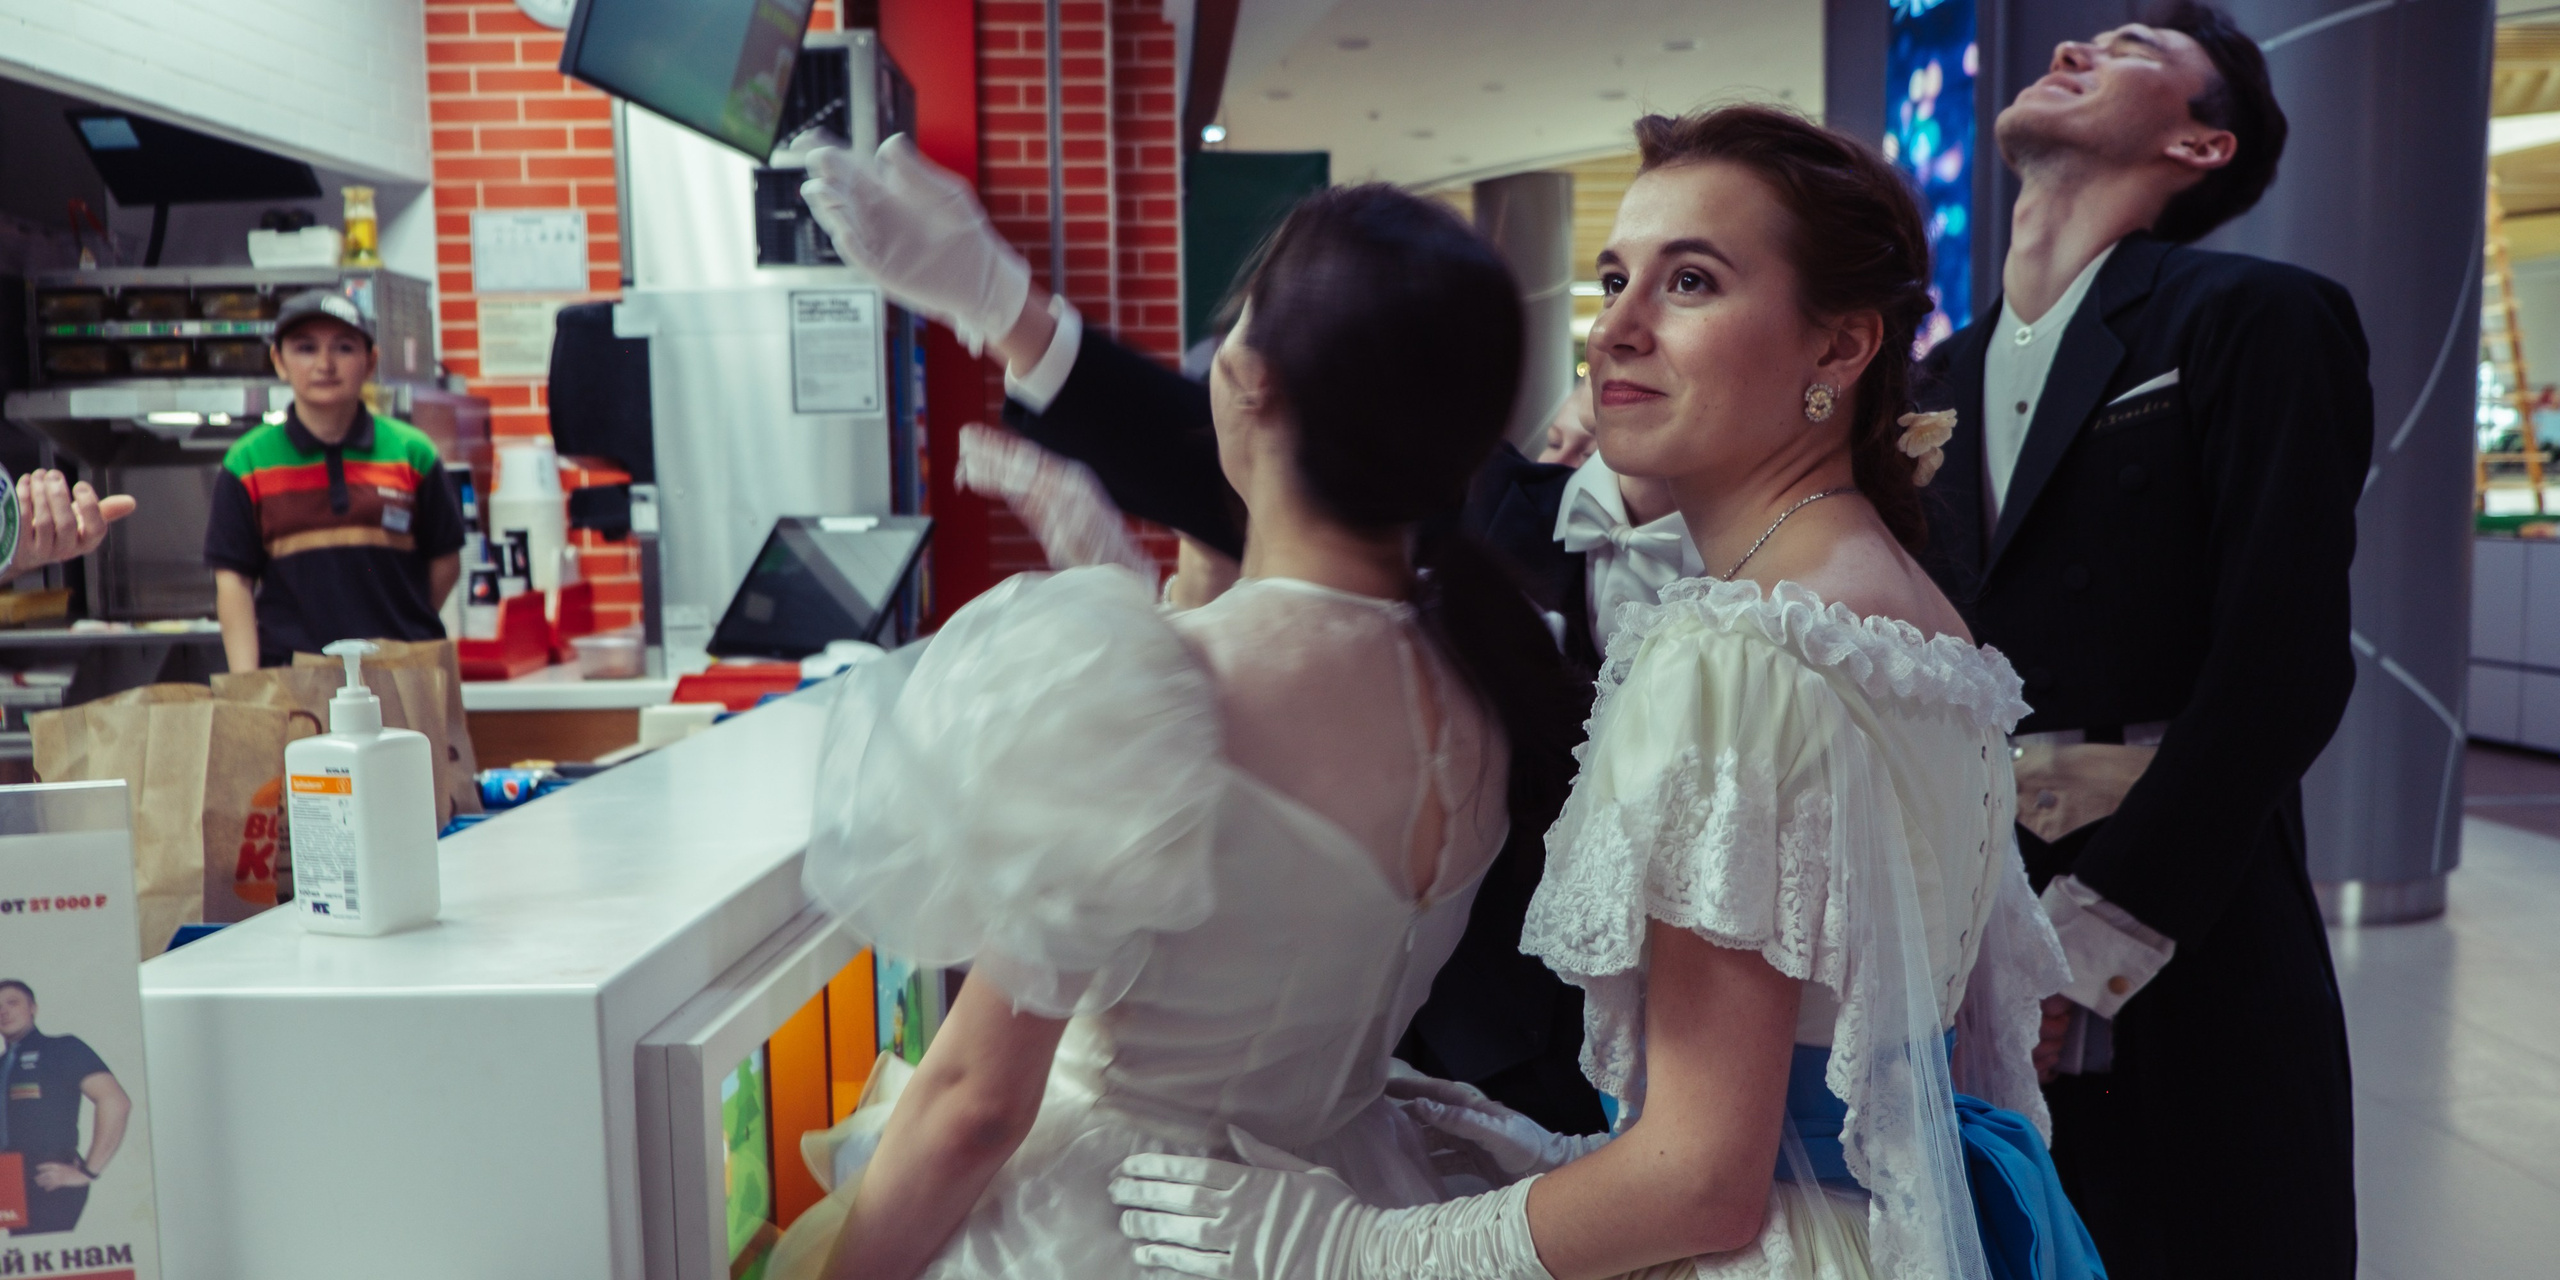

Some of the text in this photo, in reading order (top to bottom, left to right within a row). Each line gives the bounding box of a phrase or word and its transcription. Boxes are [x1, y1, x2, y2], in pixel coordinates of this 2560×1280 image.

[236, 842, 278, 881] K
[54, 894, 91, 911] 000
[0, 1247, 25, 1275] й
[61, 1243, 134, 1269] нам
